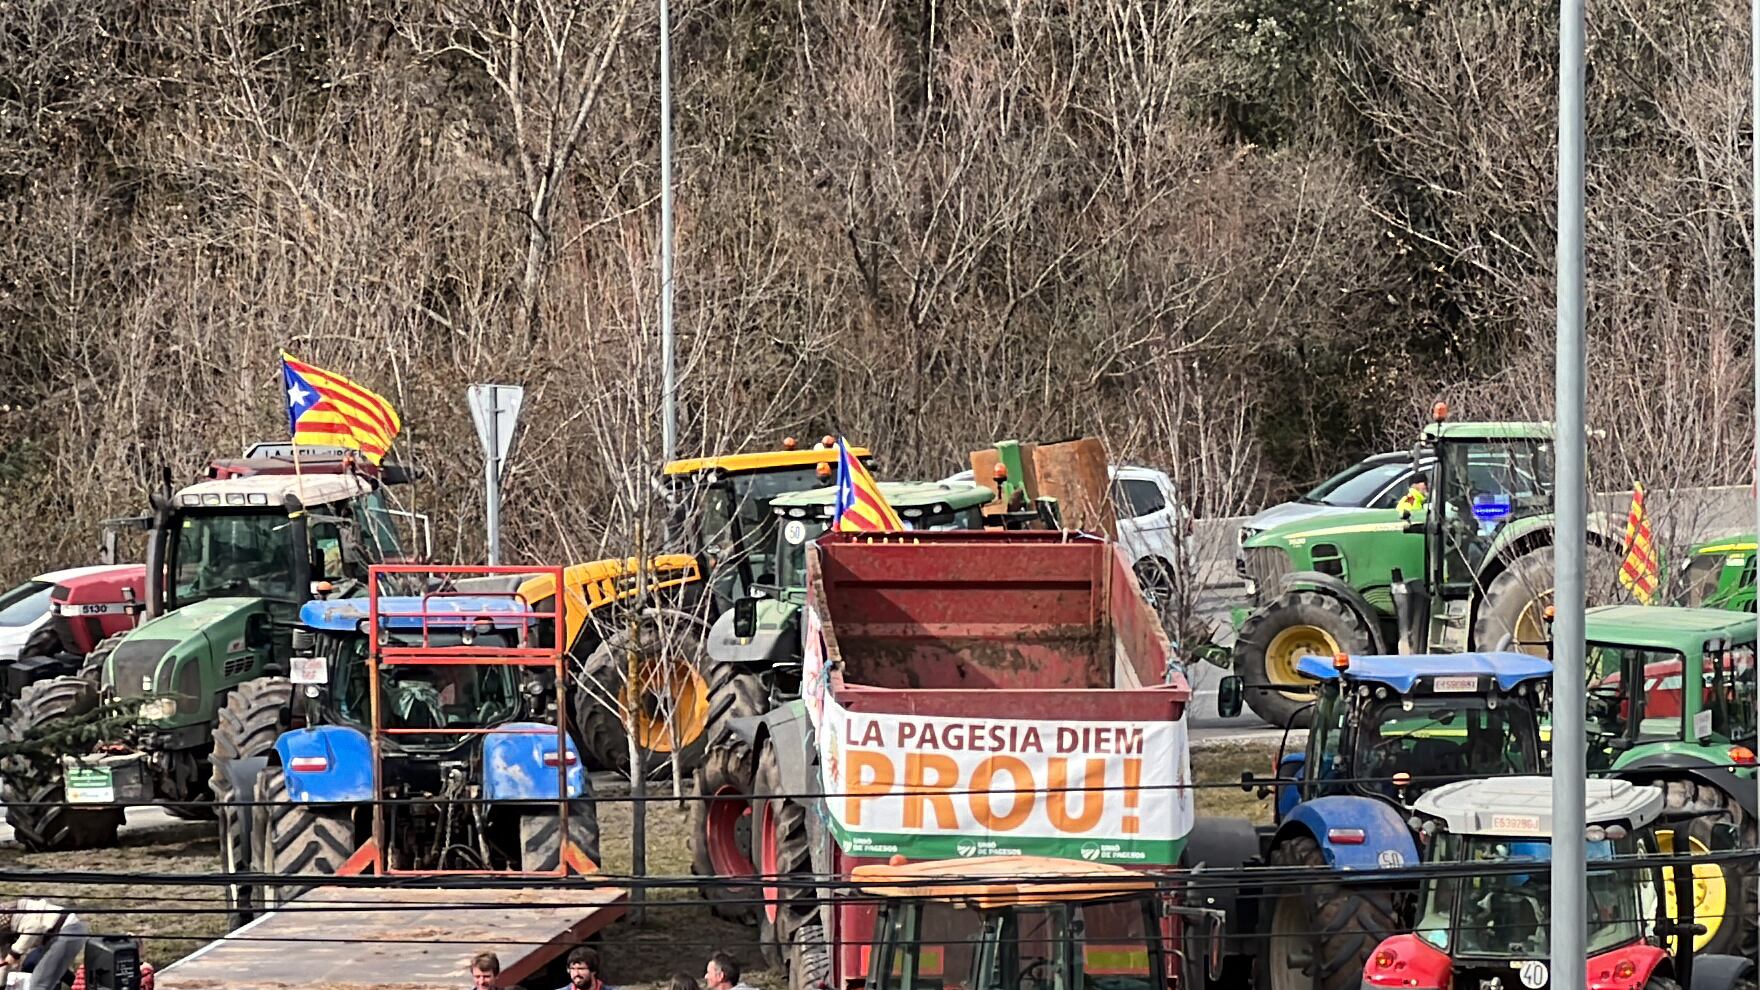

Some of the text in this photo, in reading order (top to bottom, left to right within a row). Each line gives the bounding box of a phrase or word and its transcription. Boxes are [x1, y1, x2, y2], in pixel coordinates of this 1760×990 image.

[789, 525, 801, 539] 50
[82, 604, 108, 614] 5130
[846, 718, 1144, 755] LA PAGESIA DIEM
[845, 749, 1143, 834] PROU!
[1523, 963, 1543, 986] 40
